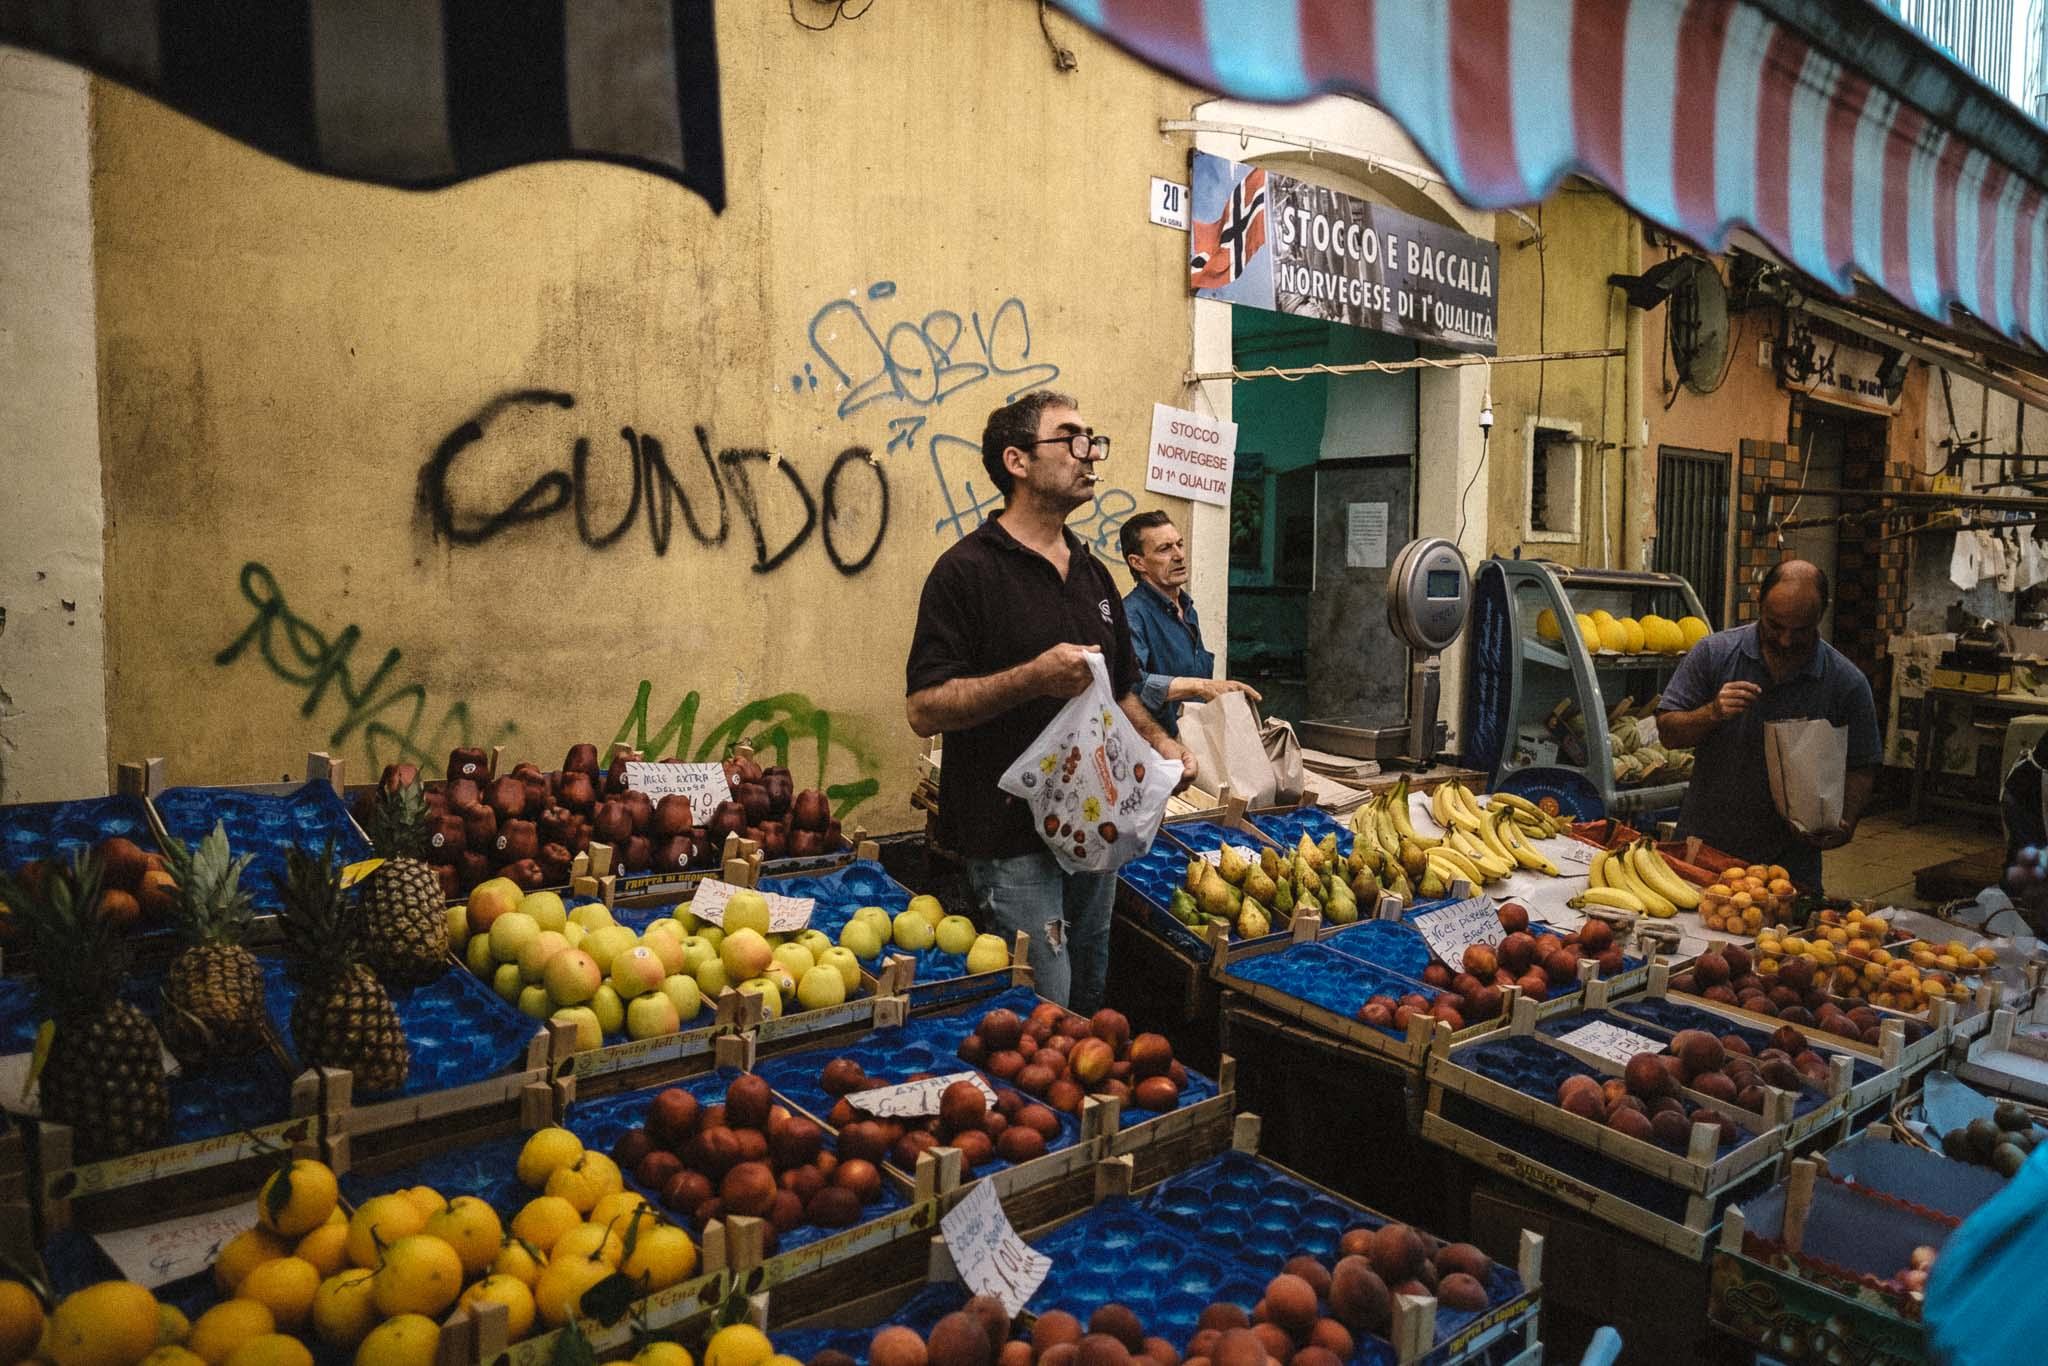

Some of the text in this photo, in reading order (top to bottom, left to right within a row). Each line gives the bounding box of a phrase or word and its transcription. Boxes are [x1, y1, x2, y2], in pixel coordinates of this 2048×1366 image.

[1163, 183, 1179, 212] 20
[1281, 206, 1493, 298] STOCCO E BACCALÀ
[1280, 263, 1391, 313] NORVEGESE
[1398, 290, 1414, 319] DI
[1435, 301, 1495, 341] QUALITÀ
[1170, 421, 1220, 444] STOCCO
[1157, 443, 1228, 471] NORVEGESE
[1151, 466, 1163, 480] DI
